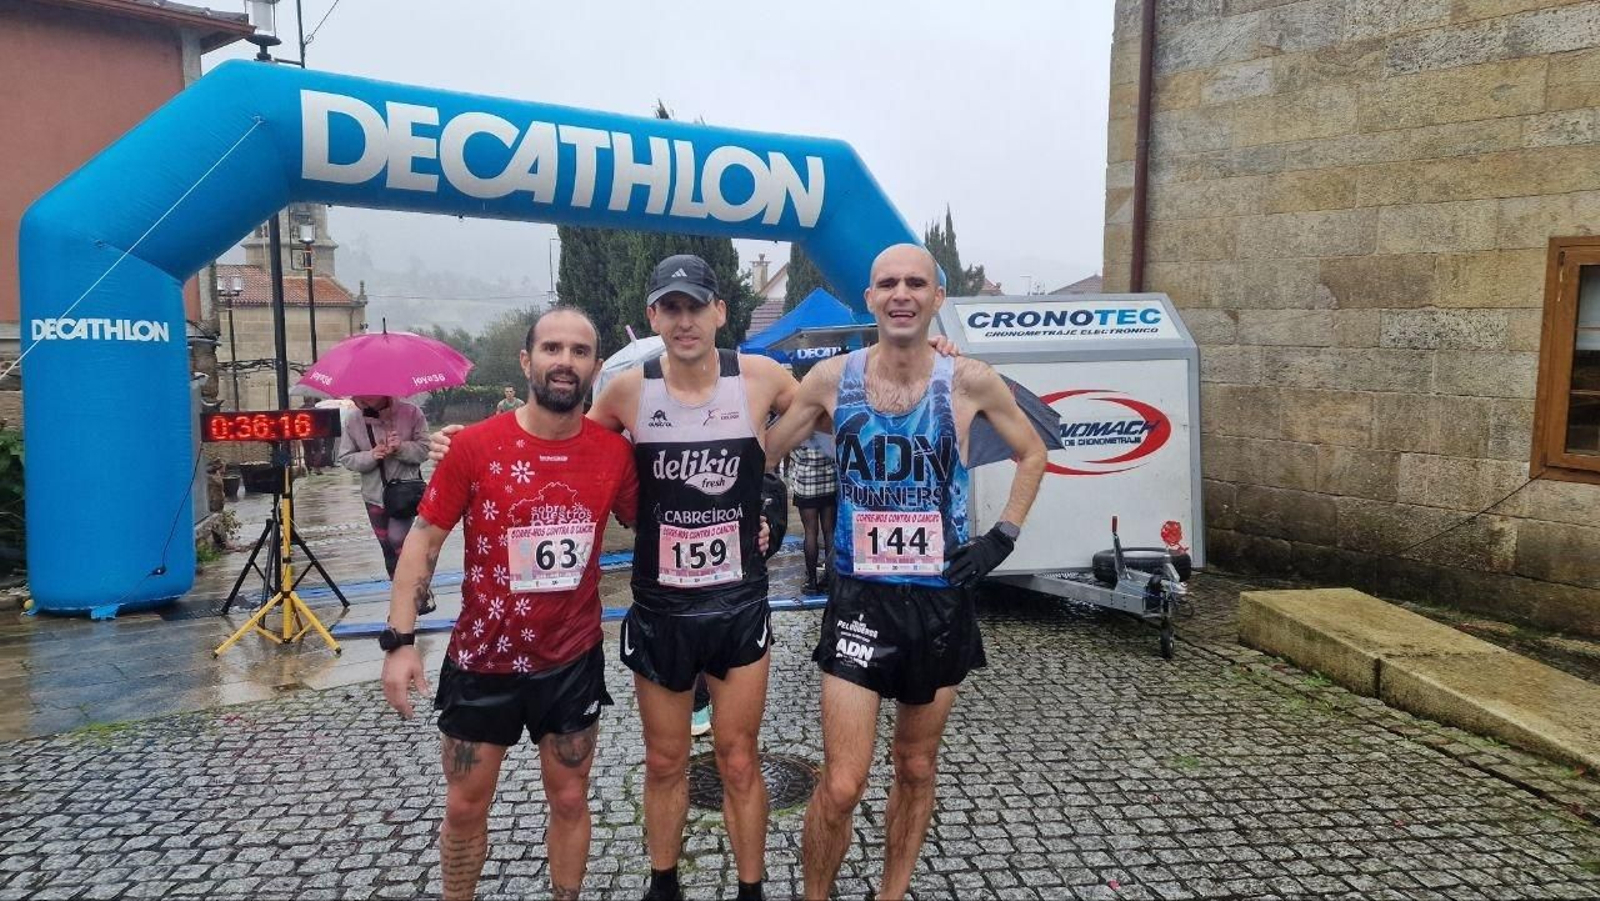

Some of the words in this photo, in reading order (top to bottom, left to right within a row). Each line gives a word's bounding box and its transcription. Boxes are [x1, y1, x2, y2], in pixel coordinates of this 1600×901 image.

[300, 89, 825, 228] DECATHLON
[31, 318, 170, 342] DECATHLON
[967, 308, 1162, 329] CRONOTEC
[985, 329, 1078, 337] CRONOMETRAJE
[796, 346, 842, 359] DECAT
[412, 373, 446, 386] joya36
[210, 414, 312, 440] 0:36:16
[1059, 420, 1160, 438] NOMACH
[1078, 436, 1142, 446] CRONOMETRAJE
[653, 448, 741, 481] delikia
[840, 434, 953, 482] ADN
[701, 478, 726, 488] fresh
[841, 484, 944, 507] RUNNERS
[531, 503, 567, 513] sobre
[531, 509, 592, 521] nuestros
[867, 526, 929, 556] 144
[535, 538, 577, 570] 63
[671, 538, 727, 569] 159
[836, 638, 875, 661] ADN
